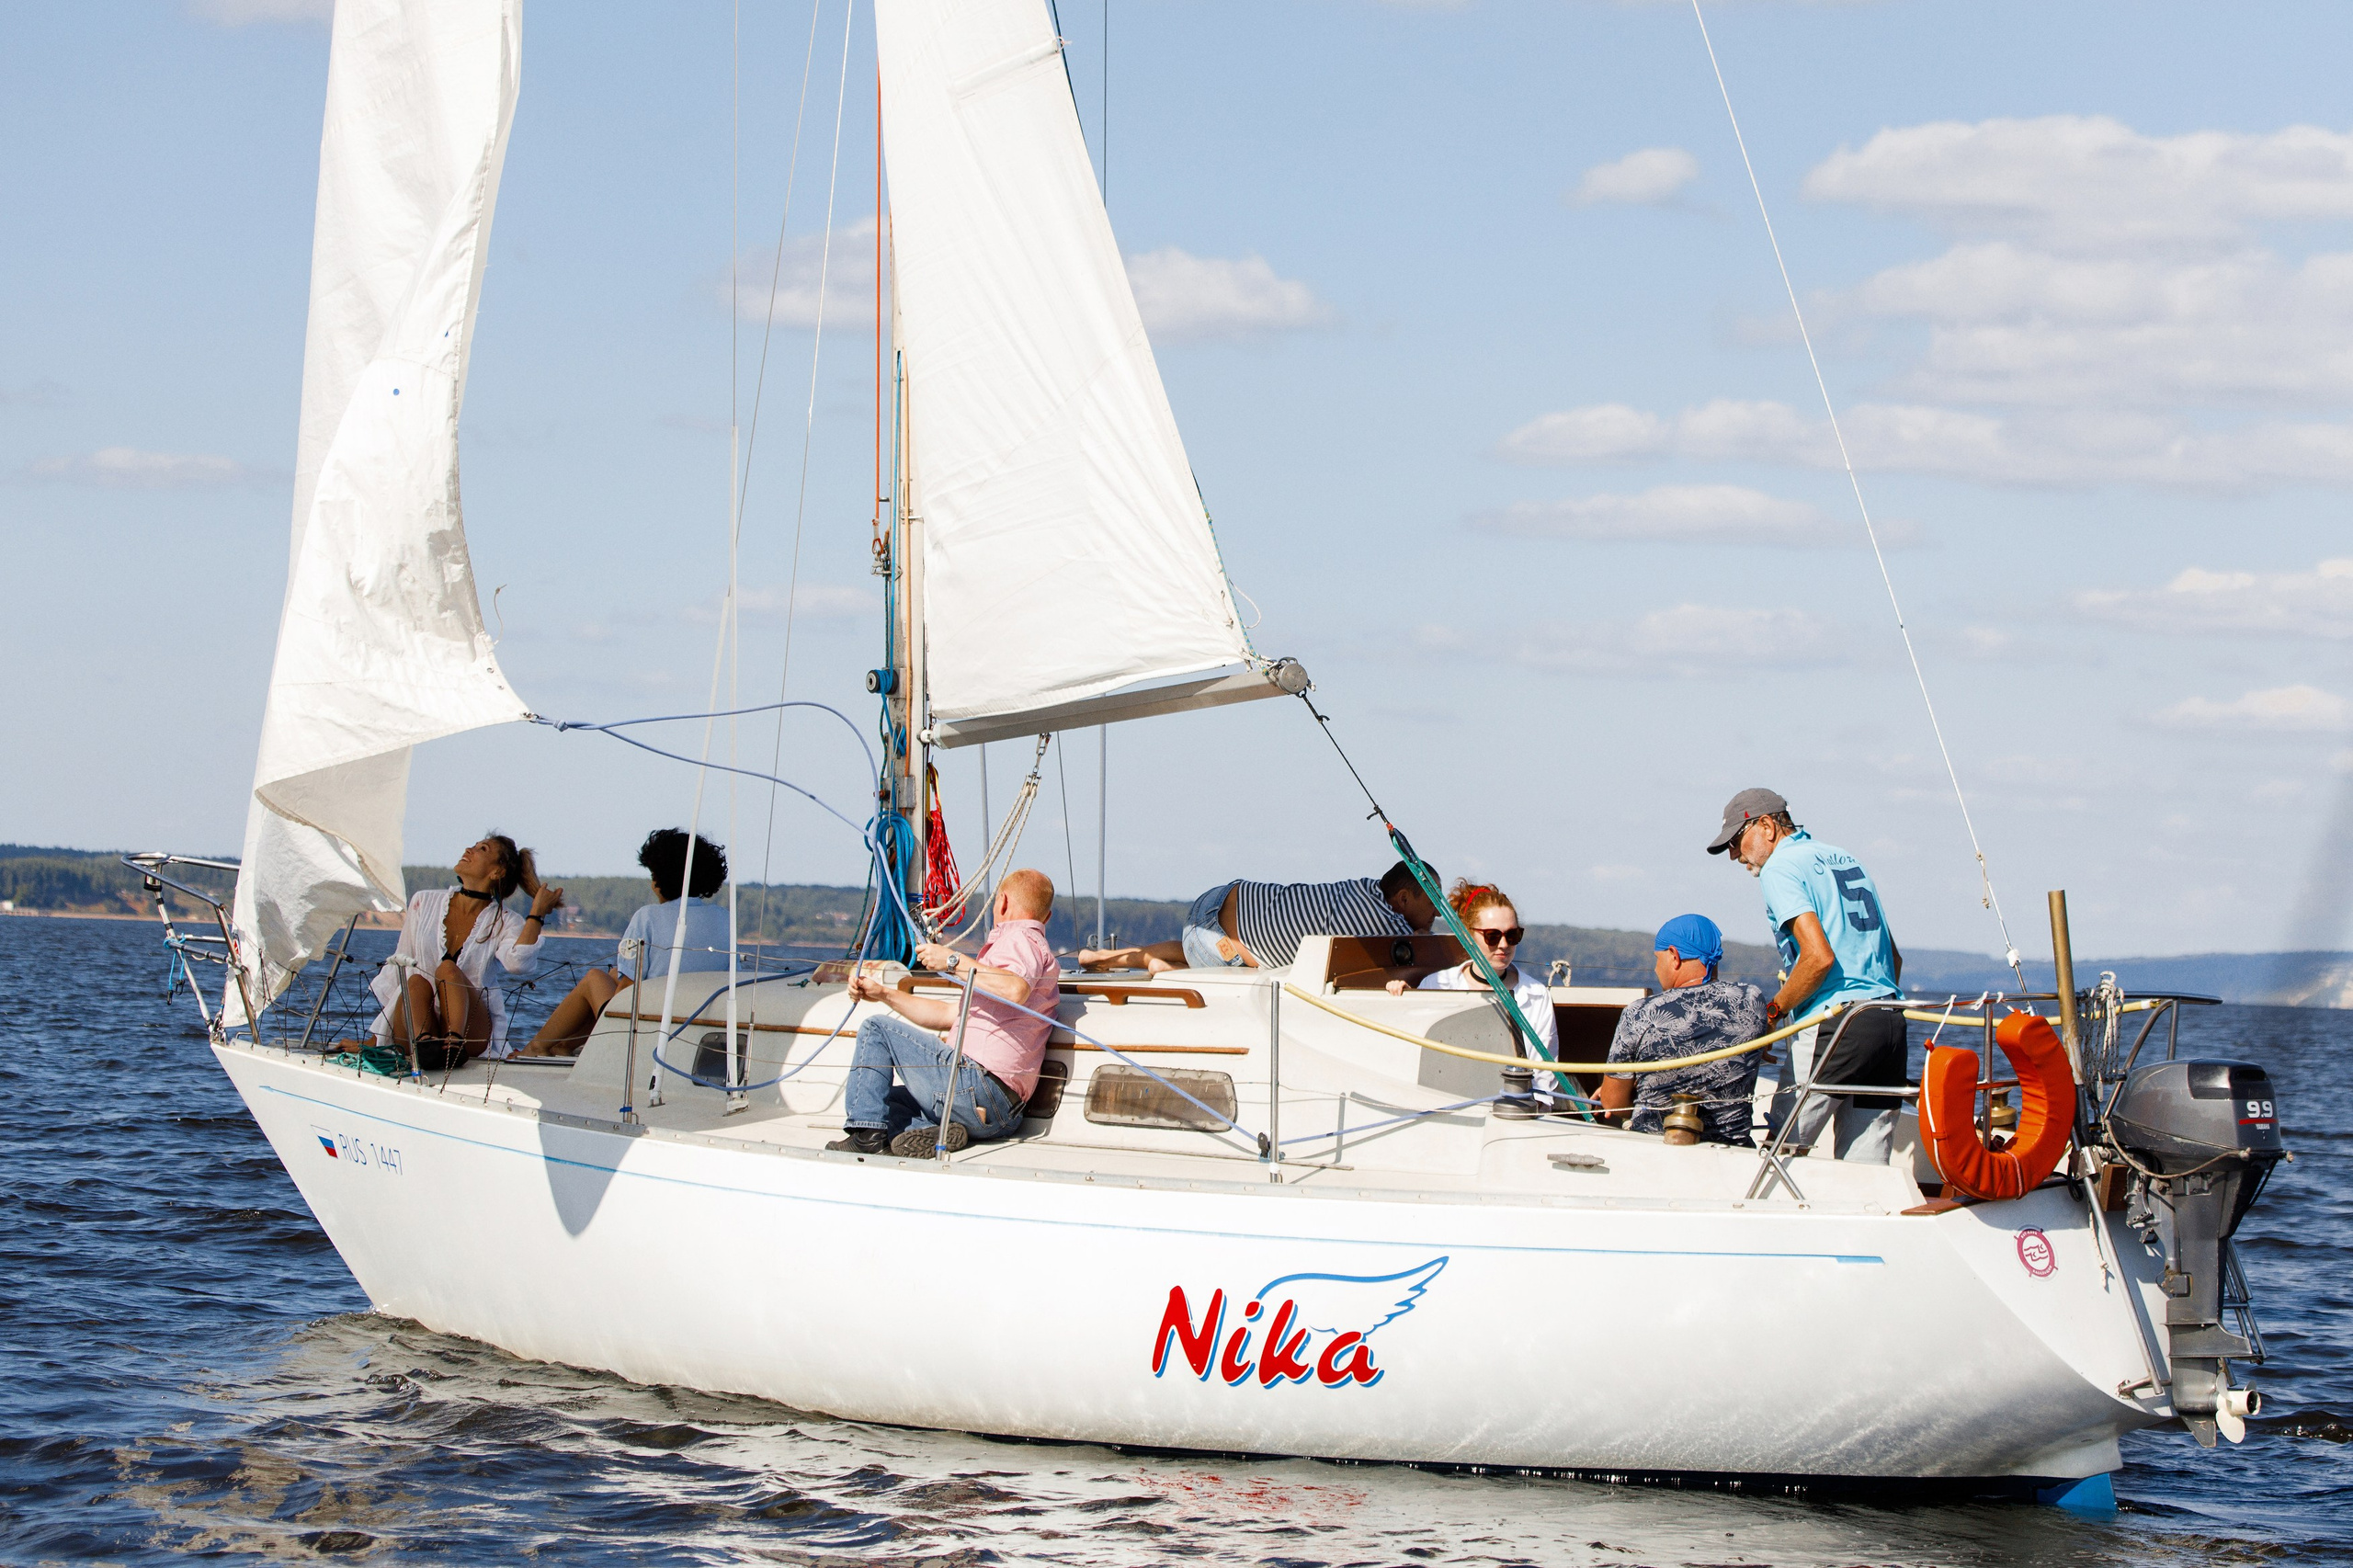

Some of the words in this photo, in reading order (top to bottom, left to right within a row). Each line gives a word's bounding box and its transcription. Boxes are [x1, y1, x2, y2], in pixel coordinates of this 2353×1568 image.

[1831, 866, 1881, 932] 5
[2246, 1100, 2273, 1118] 9.9
[338, 1133, 368, 1165] RUS
[370, 1142, 403, 1176] 1447
[1152, 1285, 1384, 1389] Nika
